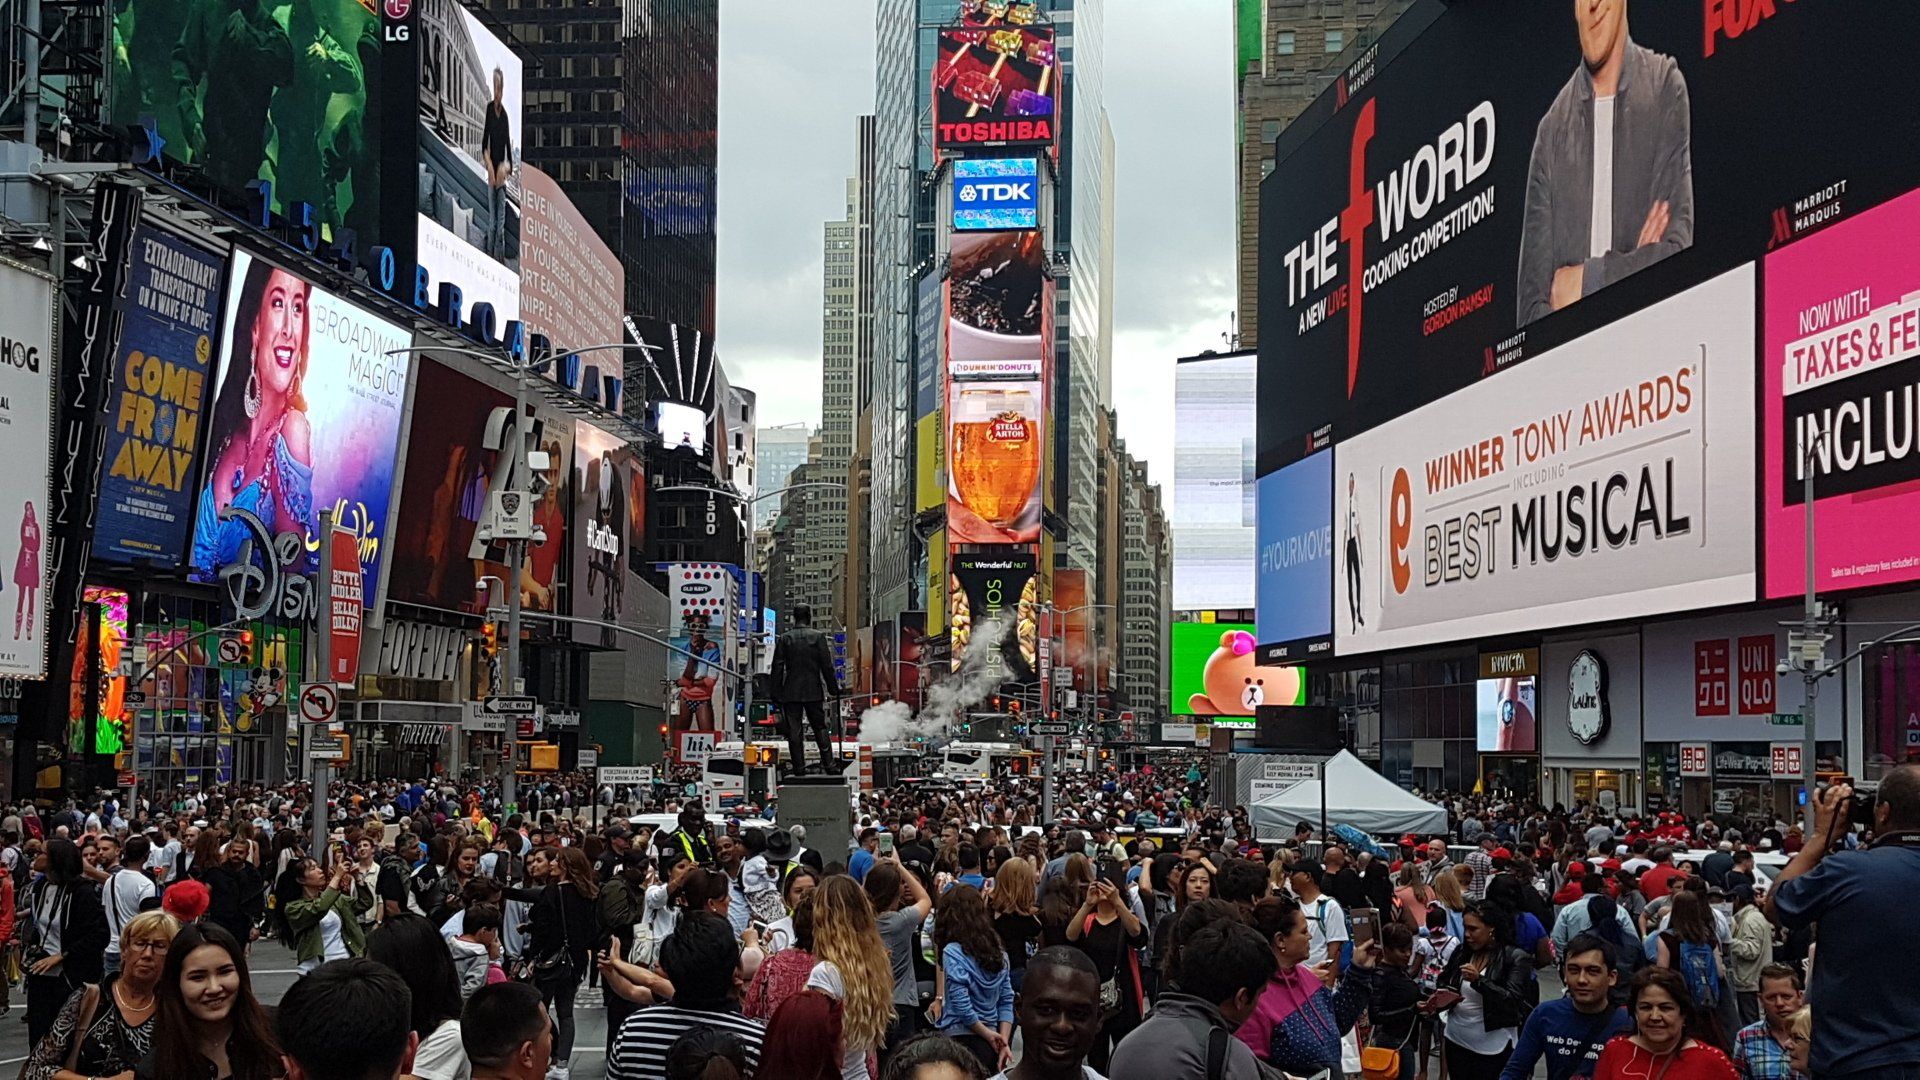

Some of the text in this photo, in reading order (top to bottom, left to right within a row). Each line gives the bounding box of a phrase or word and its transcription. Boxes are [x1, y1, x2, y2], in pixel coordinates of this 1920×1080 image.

[385, 25, 410, 42] LG
[1348, 43, 1379, 79] MARRIOTT
[1348, 64, 1376, 96] MARQUIS
[940, 120, 1051, 142] TOSHIBA
[976, 183, 1031, 200] TDK
[1795, 179, 1847, 215] MARRIOTT
[526, 217, 549, 244] GIVE
[1795, 201, 1841, 233] MARQUIS
[1283, 97, 1496, 401] THE f WORD
[1362, 186, 1496, 294] COOKING COMPETITION!
[150, 267, 206, 309] TRANSPORTS US
[1424, 285, 1459, 318] HOSTED BY
[138, 286, 150, 308] ON
[150, 290, 156, 311] A
[158, 293, 180, 320] WAVE
[180, 303, 190, 323] OF
[1298, 284, 1348, 336] A NEW LIVE
[1423, 284, 1494, 337] GORDON RAMSAY
[1800, 286, 1870, 335] NOW WITH
[415, 263, 622, 412] BROADWAY
[1496, 331, 1527, 353] MARRIOTT
[1793, 307, 1920, 384] TAXES & FE
[998, 363, 1032, 372] DONUTS
[1496, 348, 1523, 367] MARQUIS
[125, 350, 204, 411] COME
[117, 391, 199, 452] FROM
[995, 423, 1024, 431] STELLA
[995, 430, 1025, 438] ARTOIS
[1796, 384, 1920, 482] INCLU
[109, 436, 193, 492] AWAY
[1425, 435, 1504, 495] WINNER
[1512, 409, 1573, 467] TONY
[1513, 463, 1565, 491] INCLUDING
[1424, 457, 1691, 587] BEST MUSICAL
[975, 561, 1013, 569] Wonderful
[1262, 525, 1332, 574] #YOURMOVE
[331, 584, 362, 601] MIDLER
[332, 569, 360, 586] BETTE
[332, 615, 358, 630] DOLLY!
[986, 579, 1002, 678] PISTACHIOS
[377, 618, 467, 680] FOREVER
[1490, 652, 1526, 674] INVICTA
[1742, 644, 1769, 673] UNI
[499, 702, 530, 710] ONE WAY
[1742, 678, 1772, 710] QLO
[399, 724, 437, 745] FOREVER
[1773, 715, 1795, 724] W 46
[1715, 756, 1771, 772] LifeWear Pop-Up
[1547, 1035, 1565, 1045] Web
[1558, 1047, 1571, 1056] do
